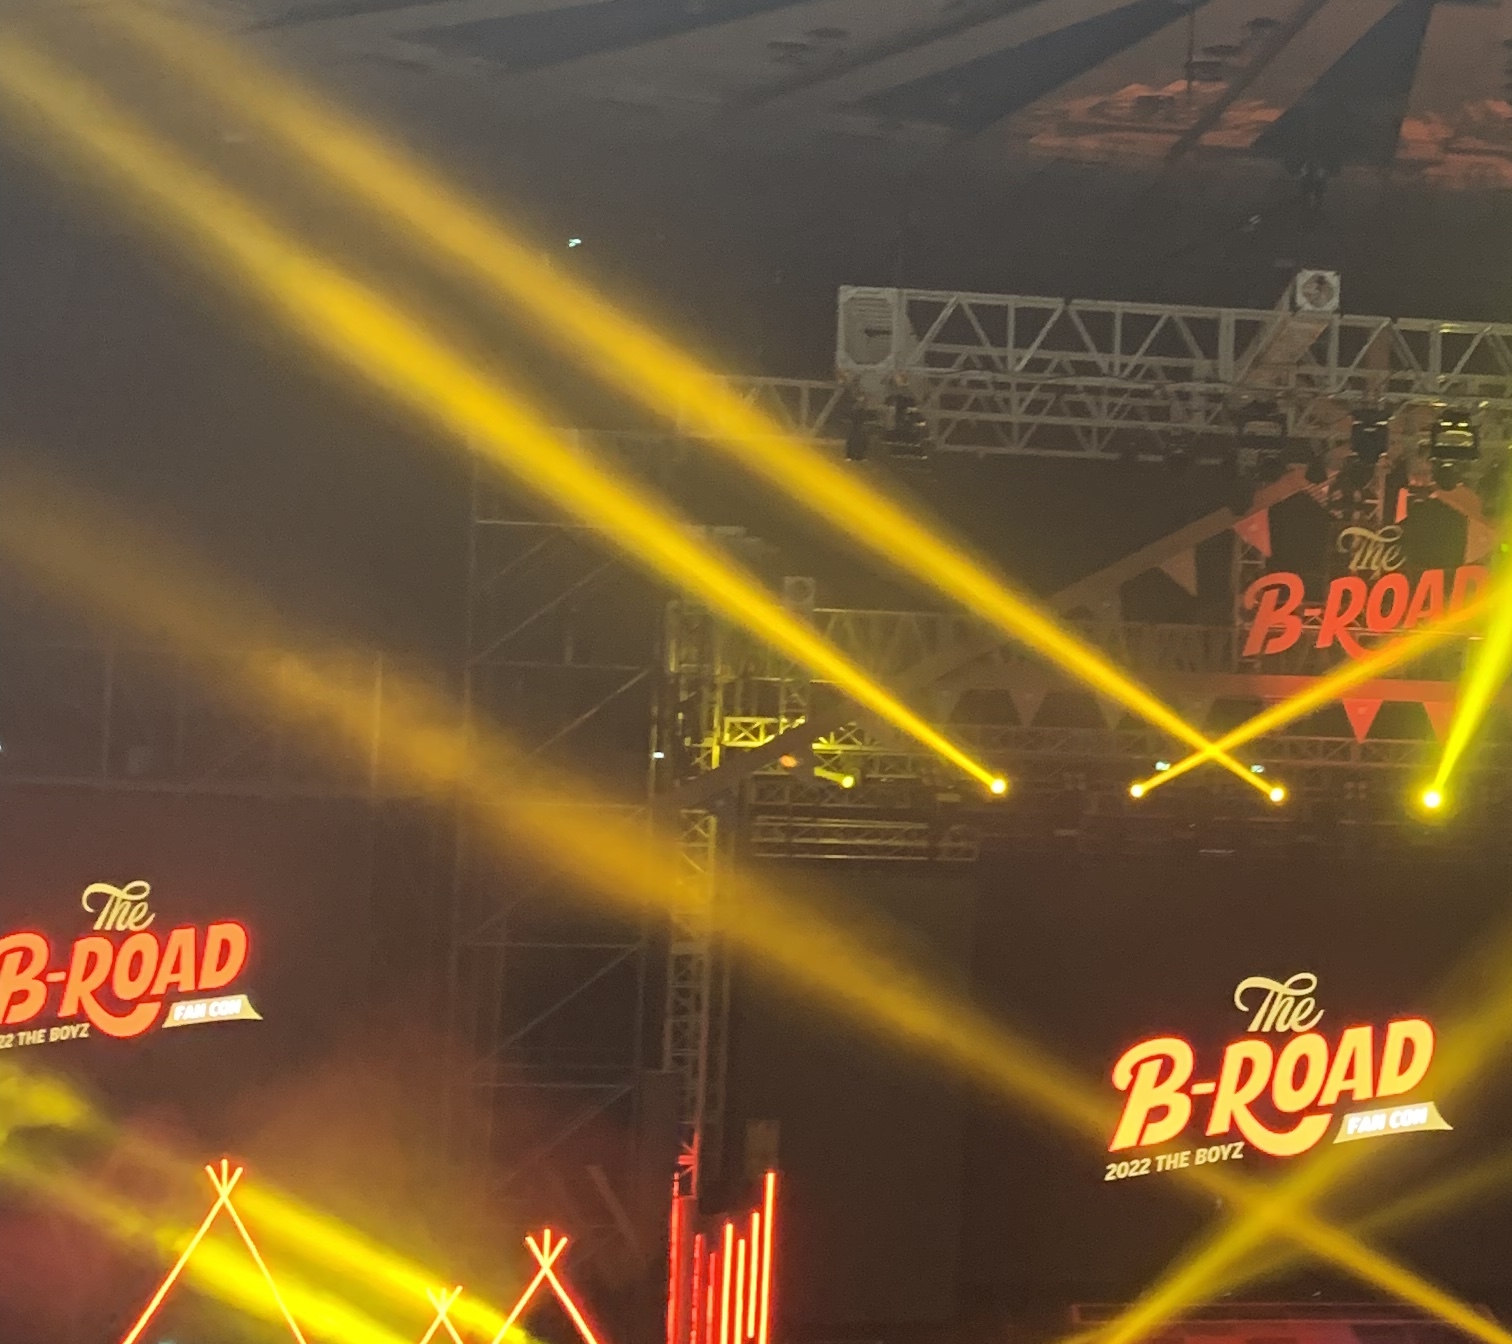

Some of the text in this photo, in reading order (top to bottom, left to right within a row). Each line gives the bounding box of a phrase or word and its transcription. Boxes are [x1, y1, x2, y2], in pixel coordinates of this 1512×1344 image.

[1336, 525, 1407, 571] The
[1243, 565, 1492, 666] B-ROAD
[82, 880, 155, 931] The
[0, 921, 248, 1038] B-ROAD
[1233, 972, 1324, 1032] The
[17, 1028, 46, 1046] THE
[50, 1022, 91, 1042] BOYZ
[1108, 1018, 1435, 1157] B-ROAD
[1346, 1107, 1429, 1135] FAN CON
[1104, 1141, 1245, 1181] 2022 THE BOYZ
